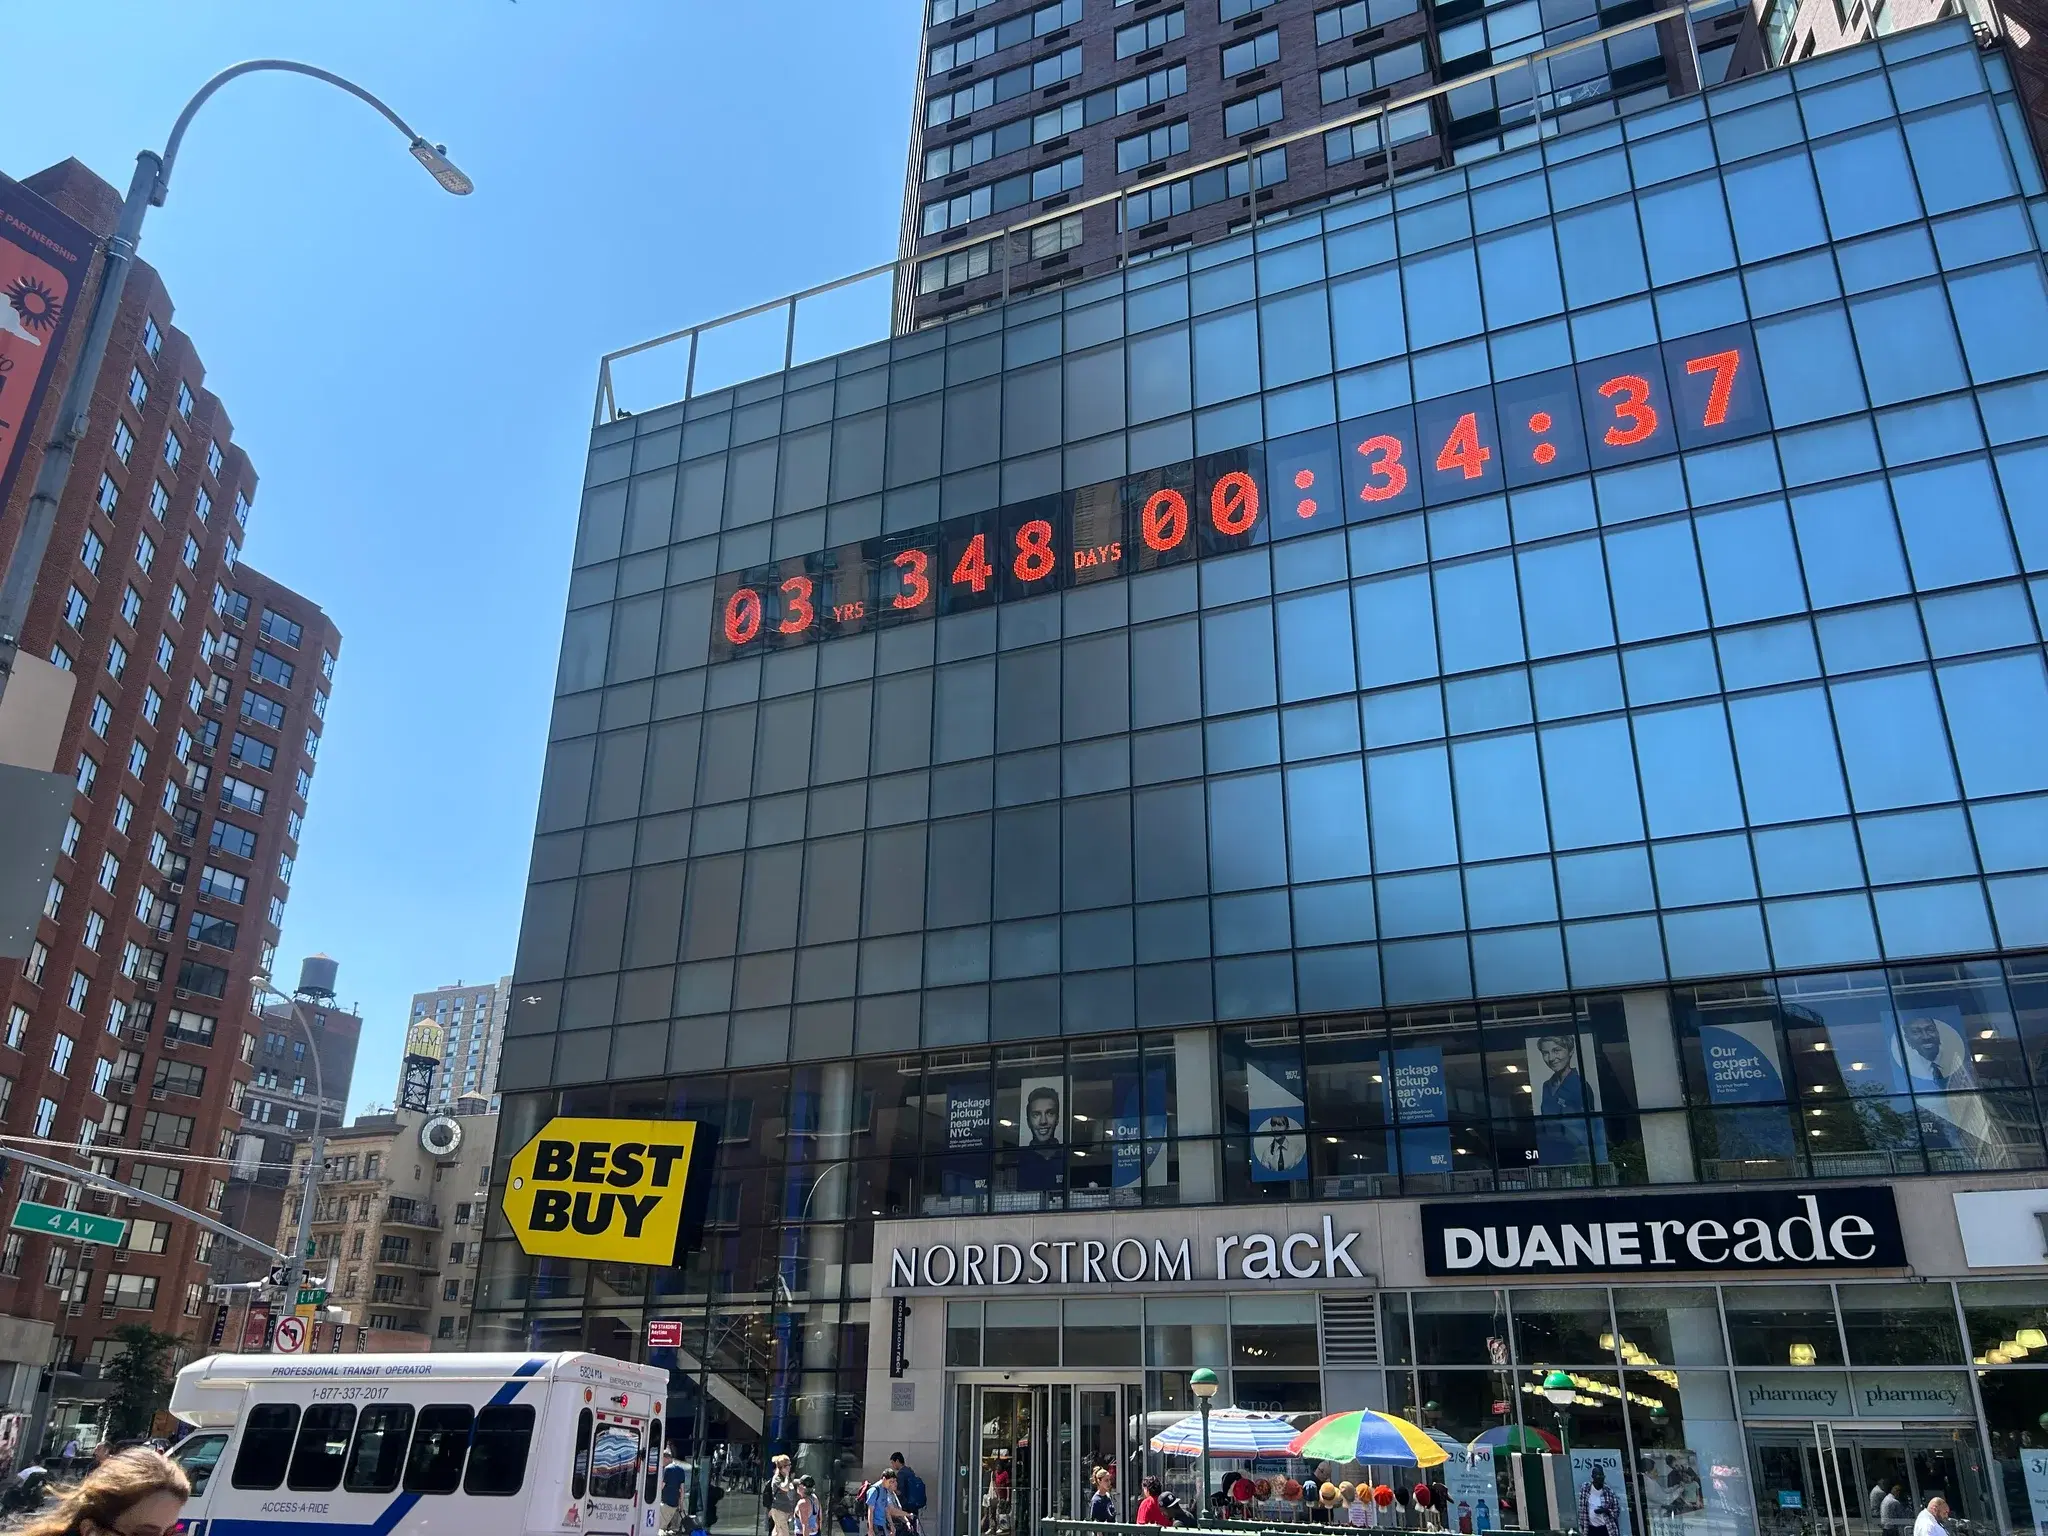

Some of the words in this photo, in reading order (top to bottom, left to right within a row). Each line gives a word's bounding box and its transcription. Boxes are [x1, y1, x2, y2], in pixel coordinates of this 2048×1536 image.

[5, 213, 78, 262] PARTNERSHIP
[724, 575, 814, 645] 03
[832, 601, 864, 624] YRS
[892, 519, 1056, 610] 348
[1074, 542, 1122, 569] DAYS
[1710, 1046, 1737, 1057] Our
[1712, 1056, 1760, 1070] expert
[1387, 1064, 1438, 1076] ackage
[1714, 1068, 1766, 1080] advice.
[1388, 1076, 1429, 1087] ickup
[1389, 1088, 1416, 1097] ear
[1417, 1086, 1443, 1097] you,
[951, 1098, 991, 1109] Package
[1390, 1097, 1420, 1108] YC.
[950, 1109, 983, 1120] pickup
[950, 1120, 972, 1128] near
[949, 1128, 973, 1138] NYC.
[1117, 1125, 1138, 1136] Our
[1117, 1144, 1156, 1156] advie.
[531, 1139, 684, 1189] BEST
[528, 1188, 663, 1239] BUY
[47, 1214, 61, 1229] 4
[66, 1217, 94, 1235] Av
[1443, 1221, 1643, 1269] DUANE
[1643, 1194, 1877, 1265] reade
[890, 1236, 1192, 1288] NORDSTROM
[1215, 1214, 1365, 1280] rack
[300, 1291, 305, 1303] E
[307, 1290, 314, 1302] 14
[272, 1366, 339, 1376] PROFESSIONAL
[342, 1366, 380, 1375] TRANSIT
[385, 1365, 432, 1375] OPERATOR
[580, 1365, 594, 1379] 5824
[312, 1386, 389, 1400] 1-877-337-2017
[1748, 1383, 1839, 1407] pharmacy
[1865, 1385, 1959, 1407] pharmacy
[261, 1502, 330, 1514] ACCESS-A-RIDE
